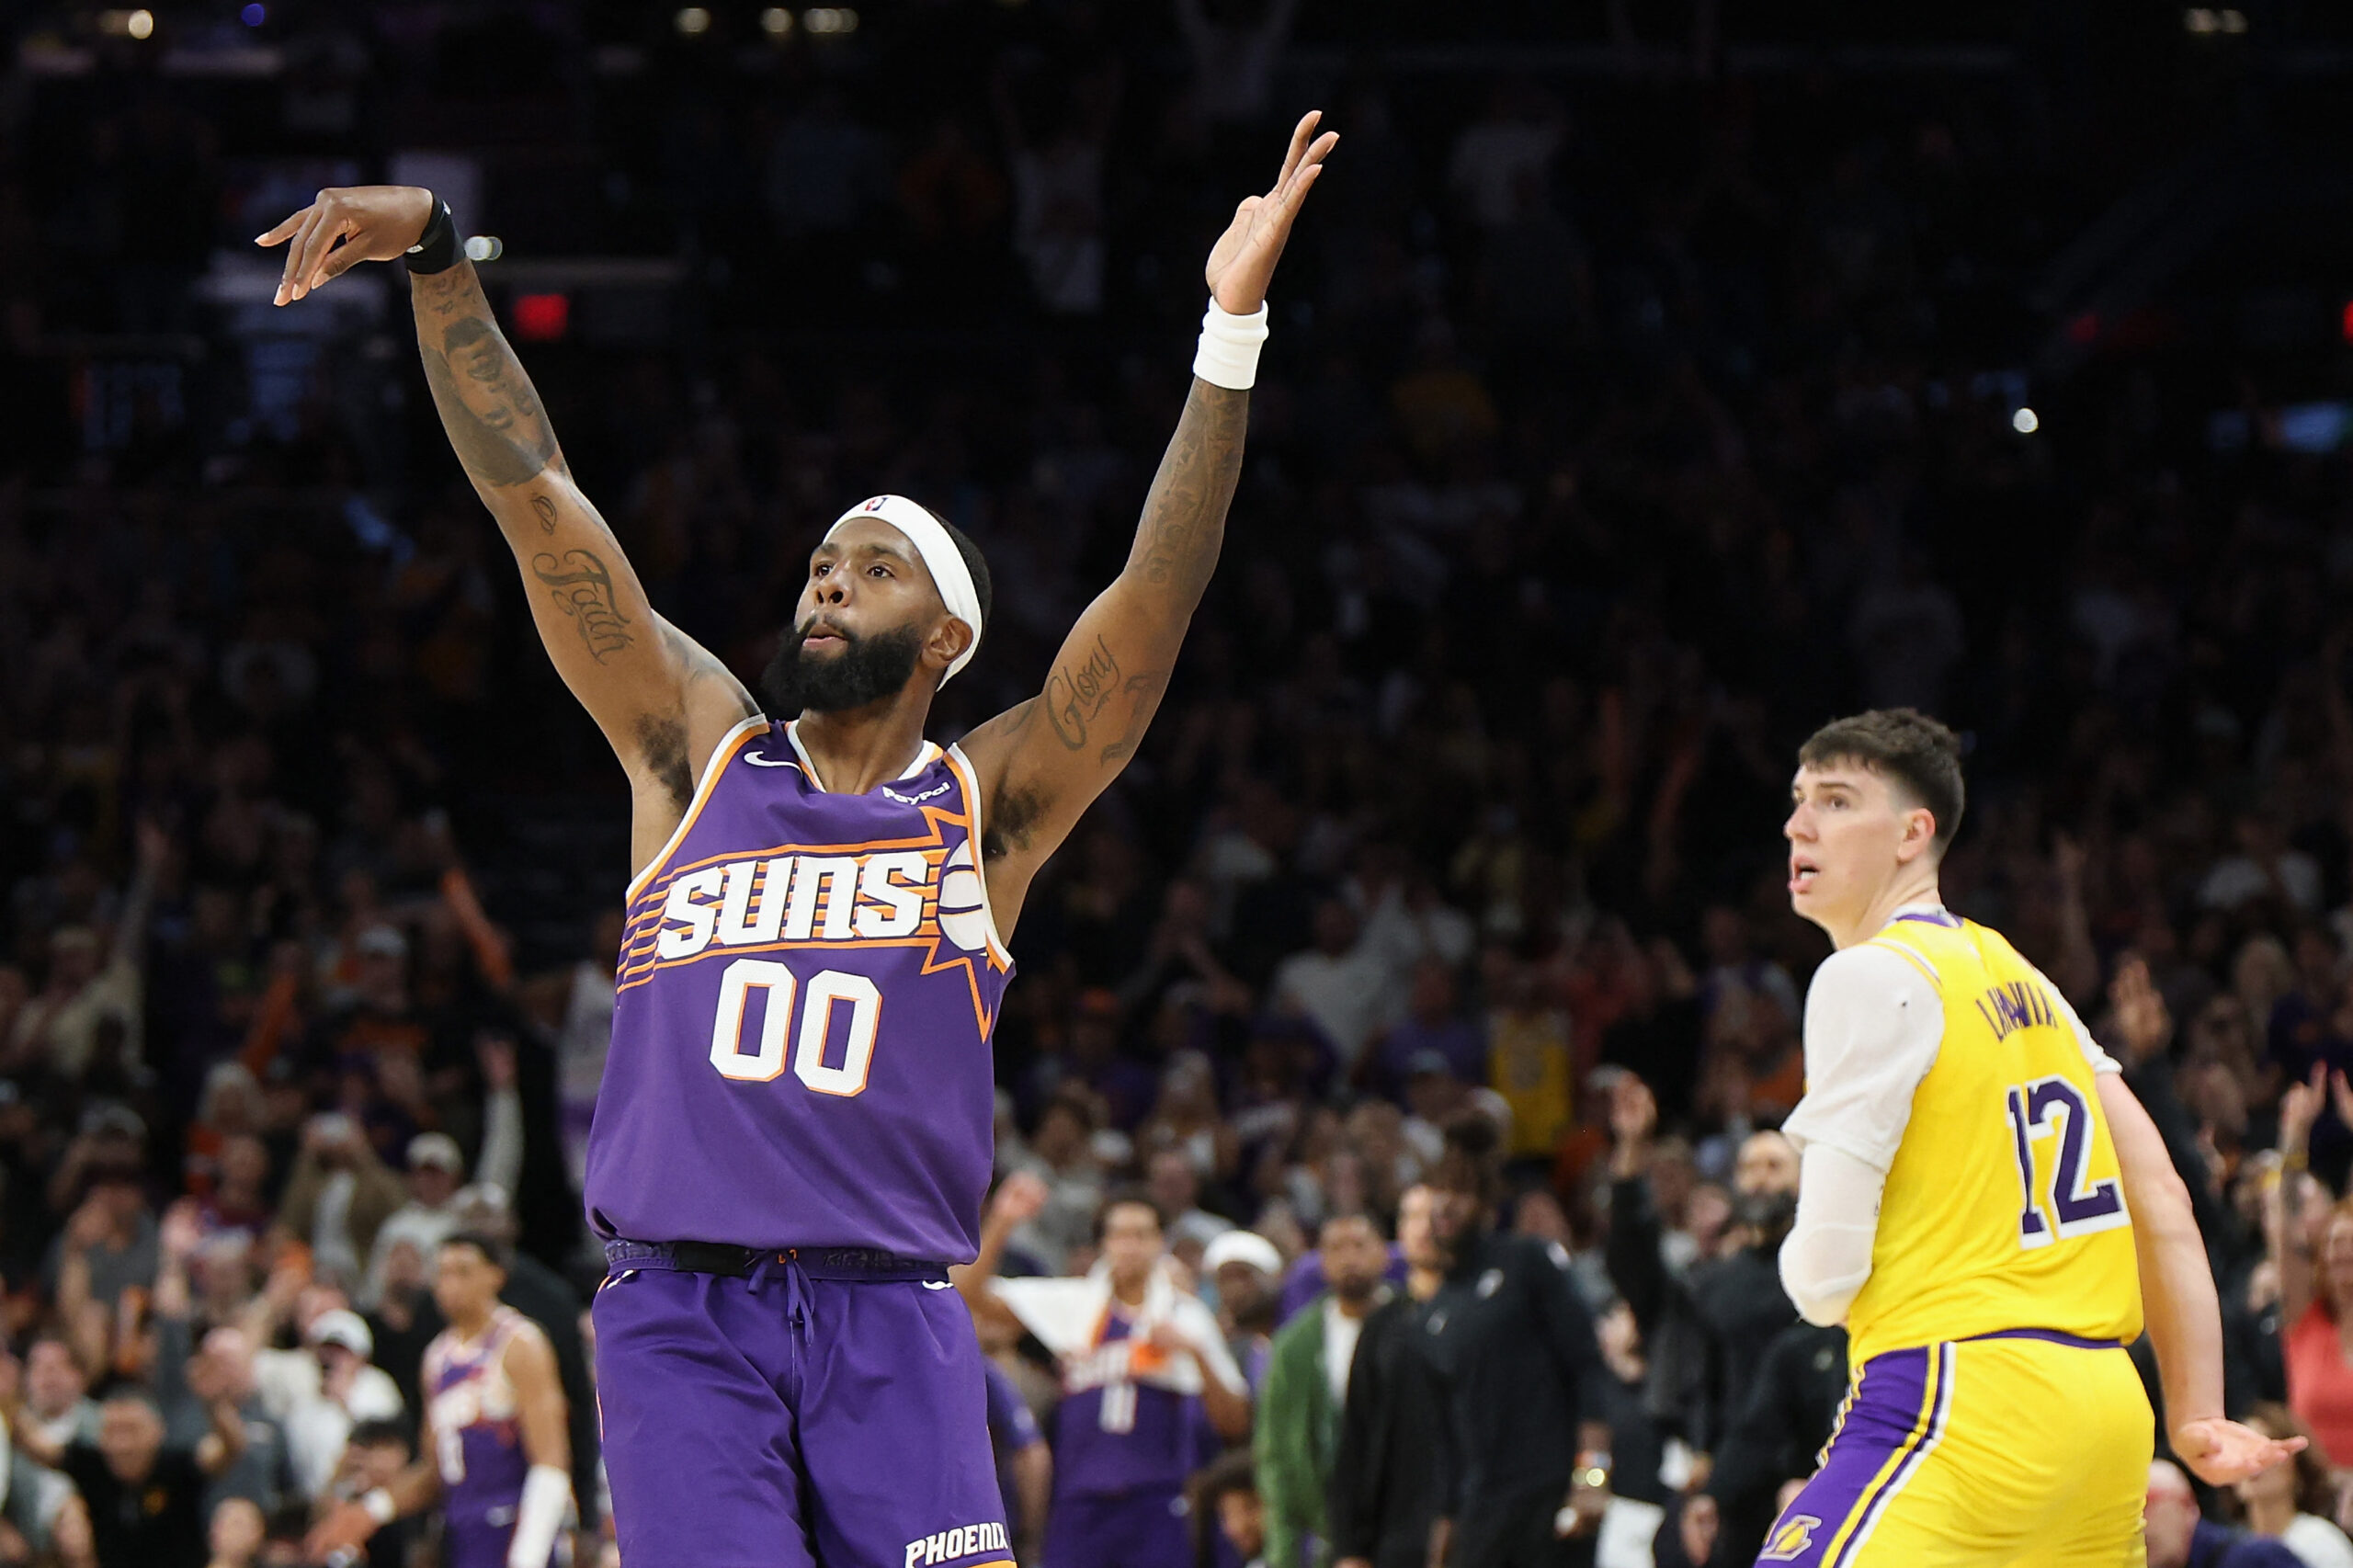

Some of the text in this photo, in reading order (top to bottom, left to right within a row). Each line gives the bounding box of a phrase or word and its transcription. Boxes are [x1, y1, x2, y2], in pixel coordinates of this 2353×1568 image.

[532, 550, 635, 665] Faith
[1047, 633, 1120, 750] Glory
[882, 781, 950, 806] PayPal
[656, 850, 929, 960] SUNS
[709, 958, 883, 1097] 00
[2007, 1074, 2131, 1250] 12
